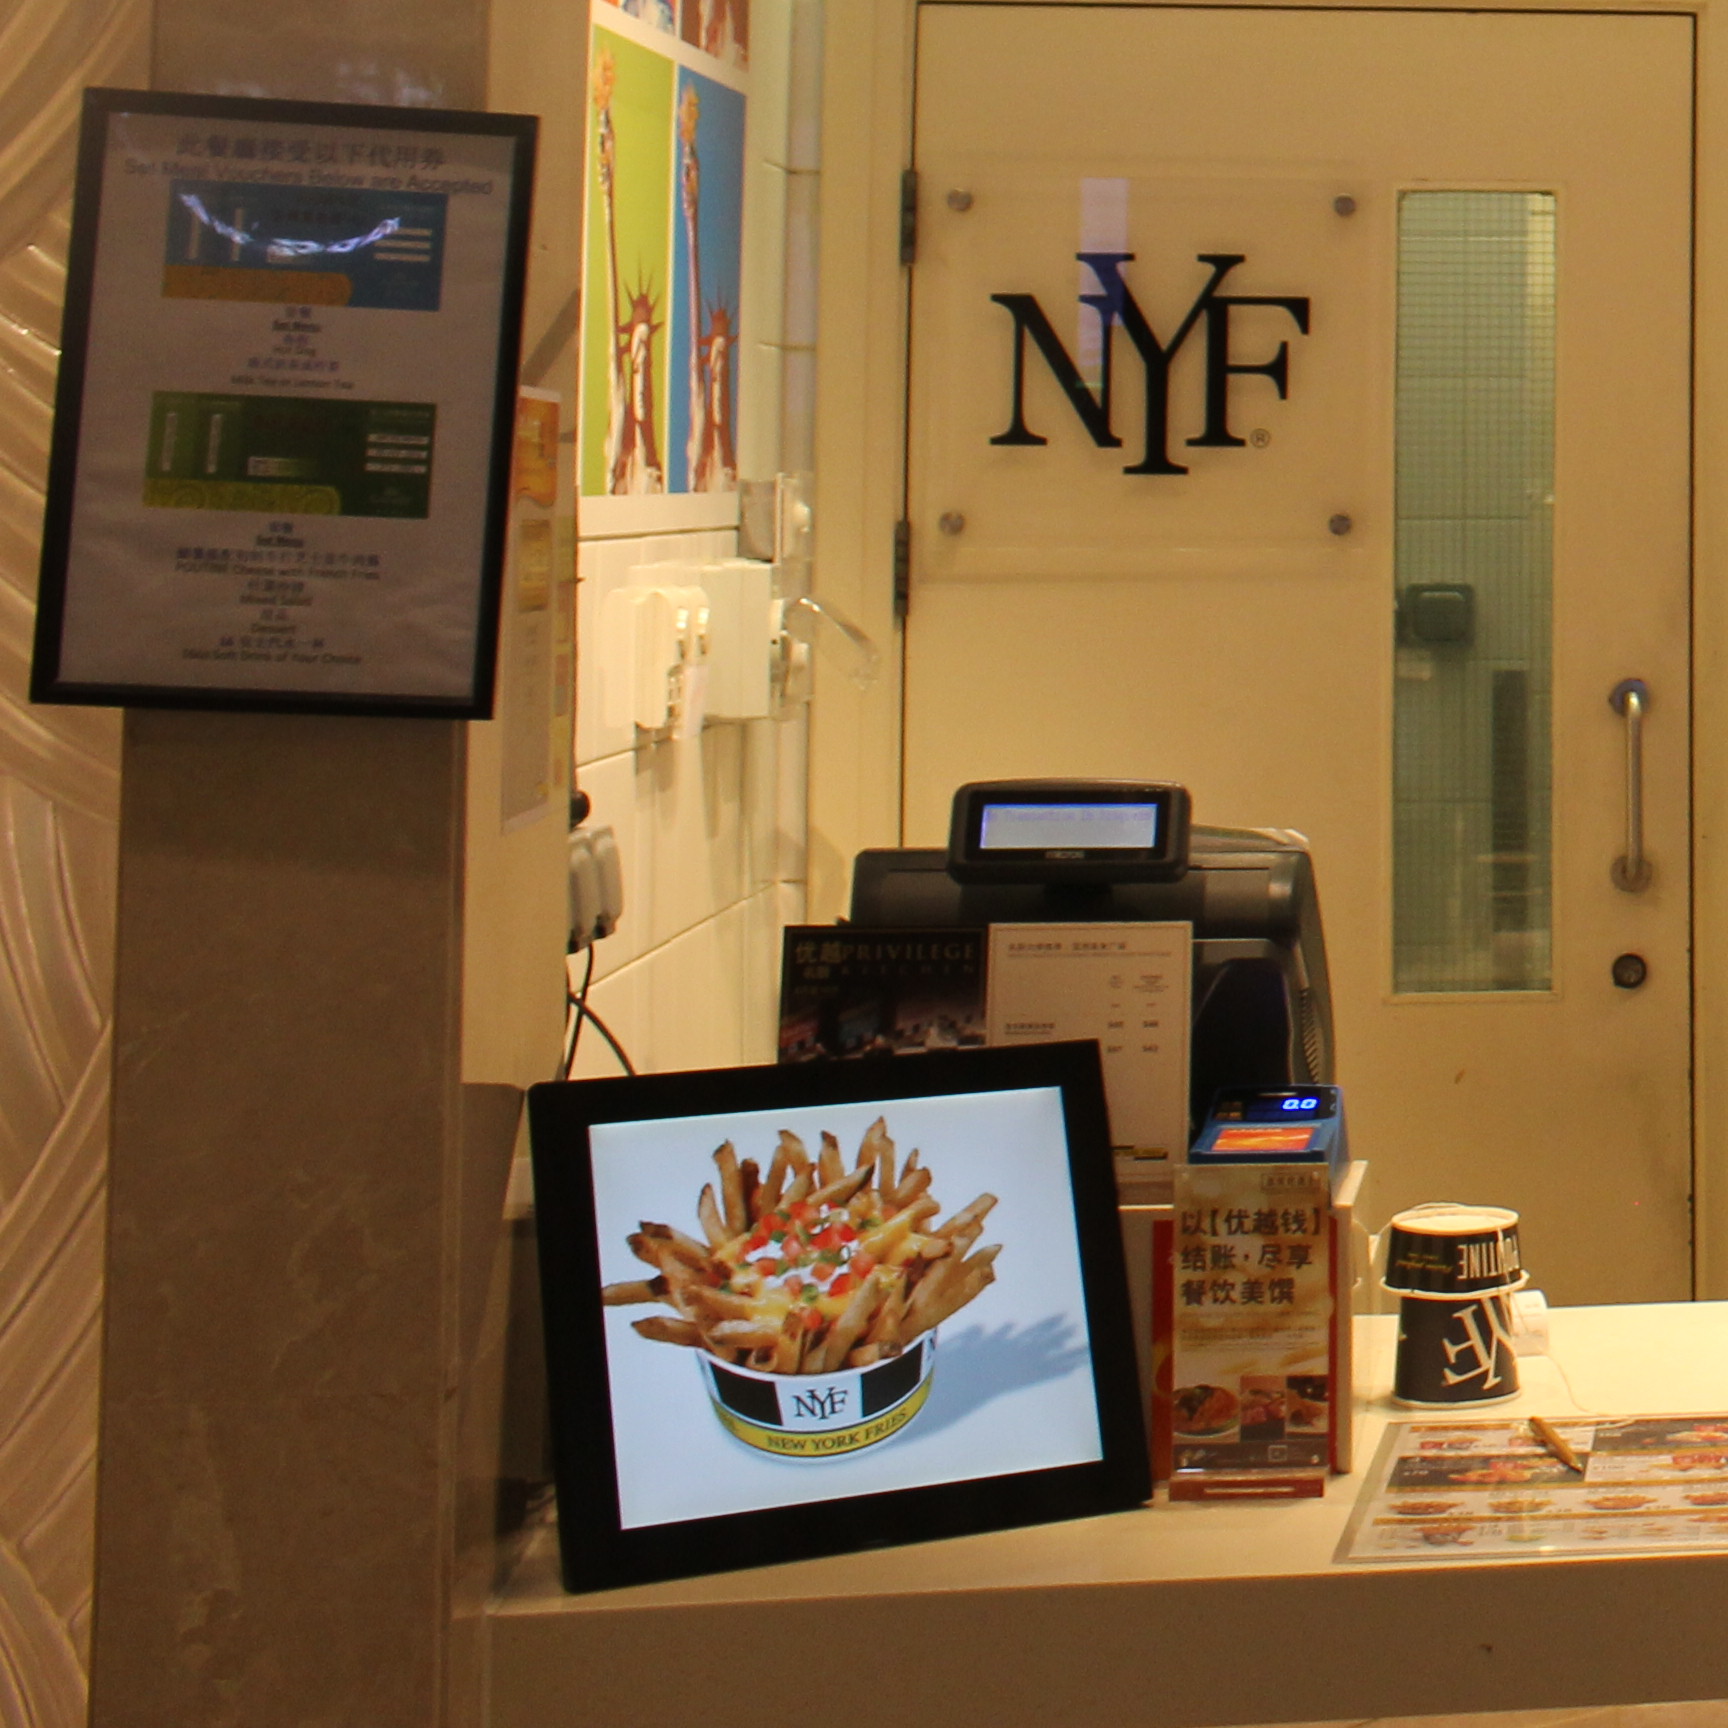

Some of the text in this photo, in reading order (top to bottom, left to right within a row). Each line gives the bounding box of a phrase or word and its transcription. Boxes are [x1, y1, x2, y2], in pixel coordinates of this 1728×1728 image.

[308, 169, 364, 188] Below
[406, 174, 493, 195] Accepted
[989, 252, 1311, 475] NYF
[841, 942, 975, 961] PRIVILEGE
[791, 1386, 848, 1421] NYF
[766, 1407, 909, 1451] NEW YORK FRIES
